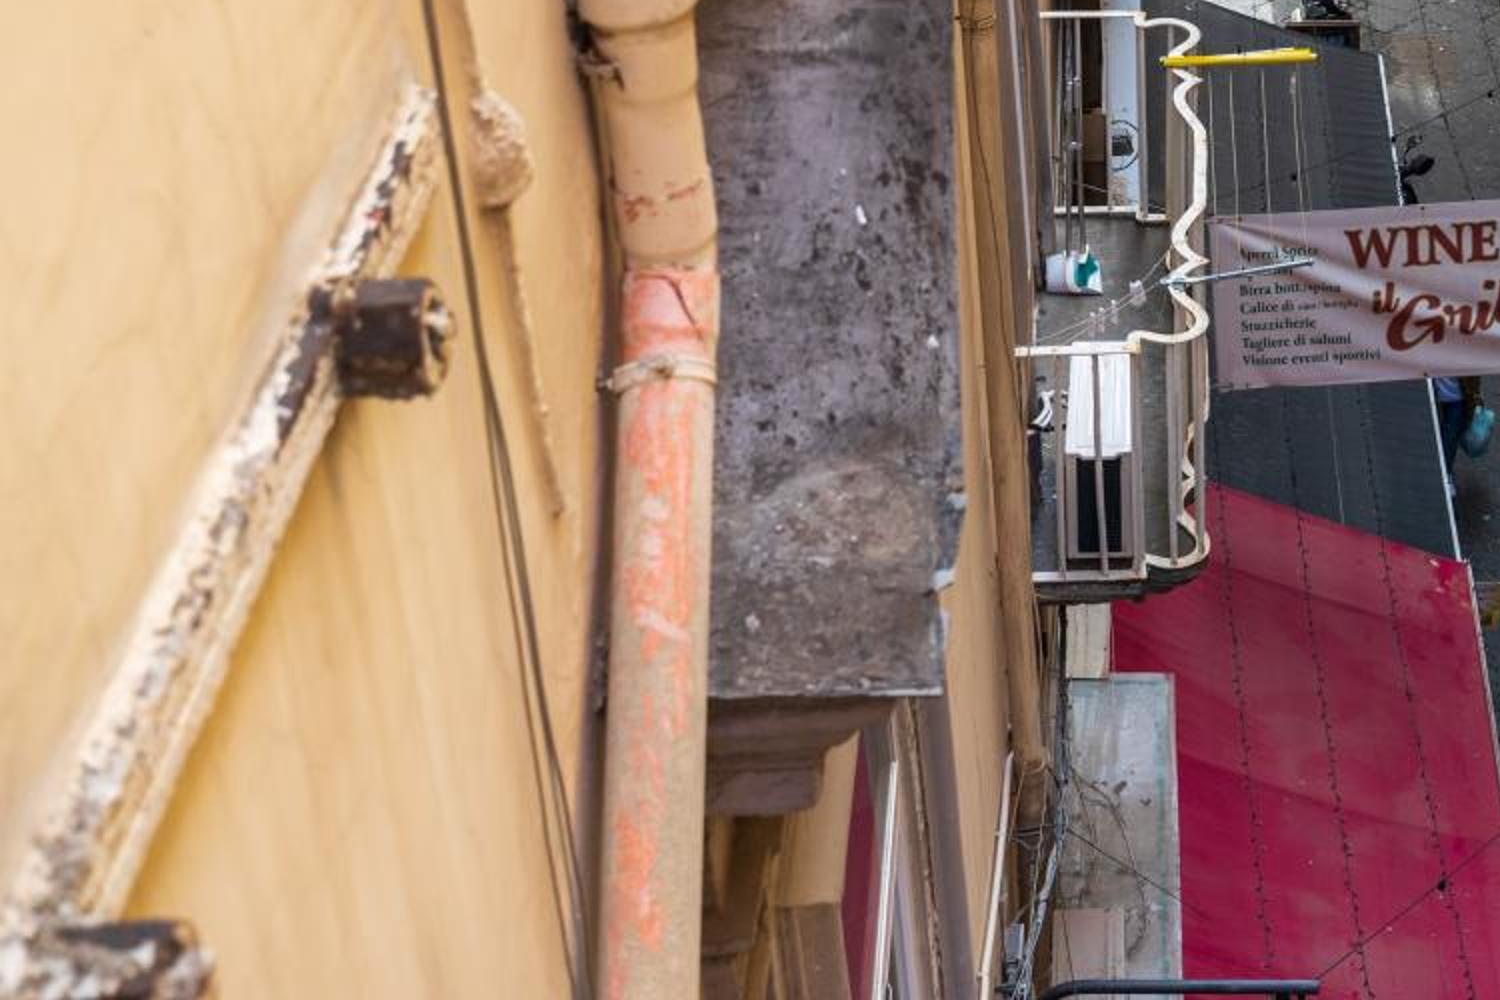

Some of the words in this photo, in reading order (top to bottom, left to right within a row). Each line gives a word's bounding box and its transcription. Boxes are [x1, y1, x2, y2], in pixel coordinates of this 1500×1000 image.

[1344, 220, 1500, 269] WINE
[1240, 283, 1272, 297] Birra
[1372, 281, 1400, 314] il
[1241, 300, 1279, 315] Calice
[1243, 335, 1292, 352] Tagliere
[1293, 333, 1307, 346] di
[1310, 331, 1352, 345] salumi
[1243, 352, 1289, 366] Visione
[1291, 350, 1329, 364] eventi
[1332, 346, 1381, 366] sportivi
